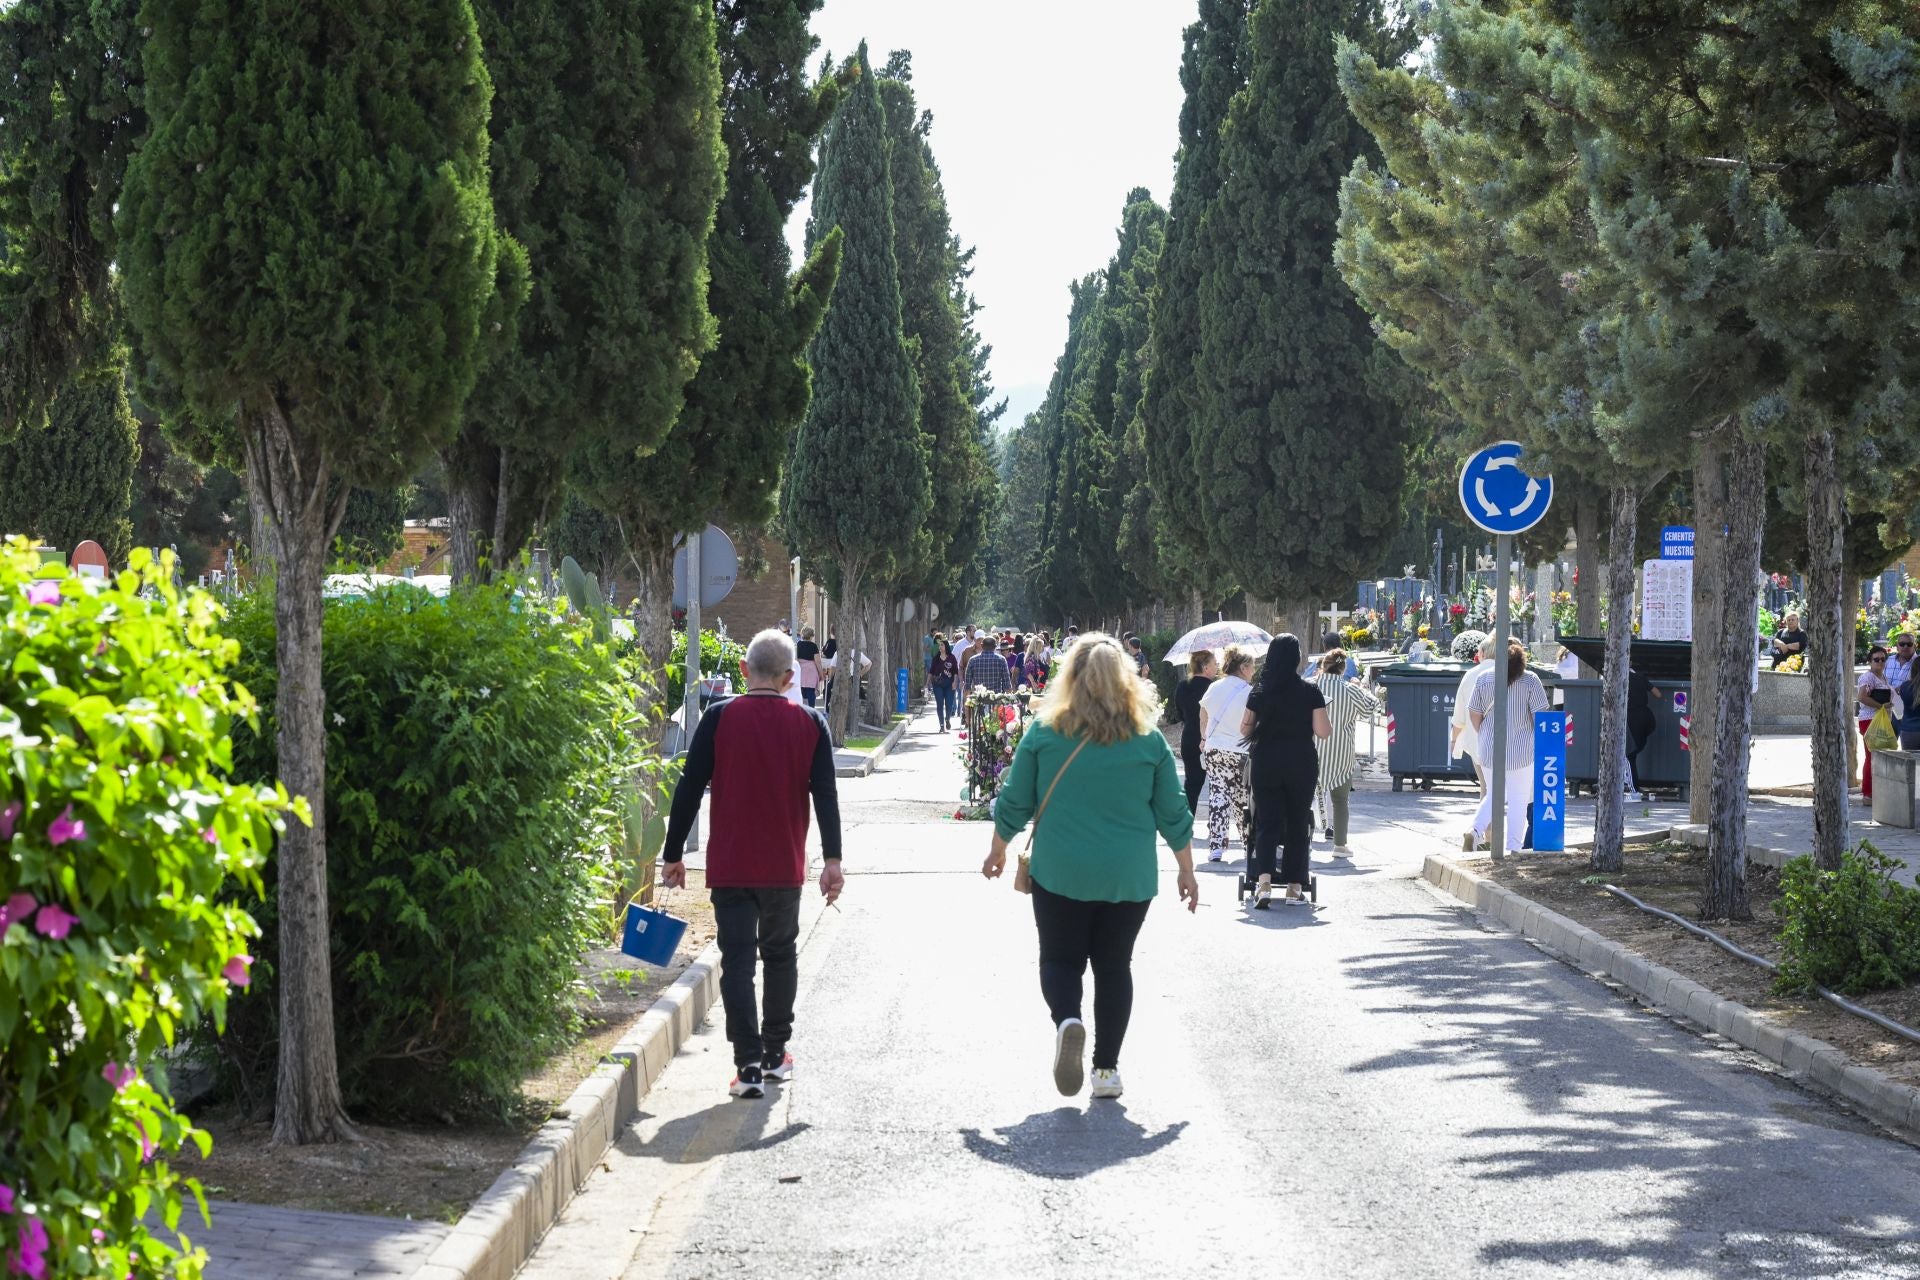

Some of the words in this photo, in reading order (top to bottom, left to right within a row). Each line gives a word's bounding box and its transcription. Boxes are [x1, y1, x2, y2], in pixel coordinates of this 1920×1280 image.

[1664, 545, 1694, 556] NUESTRO
[1539, 721, 1560, 733] 13
[1542, 756, 1558, 821] ZONA
